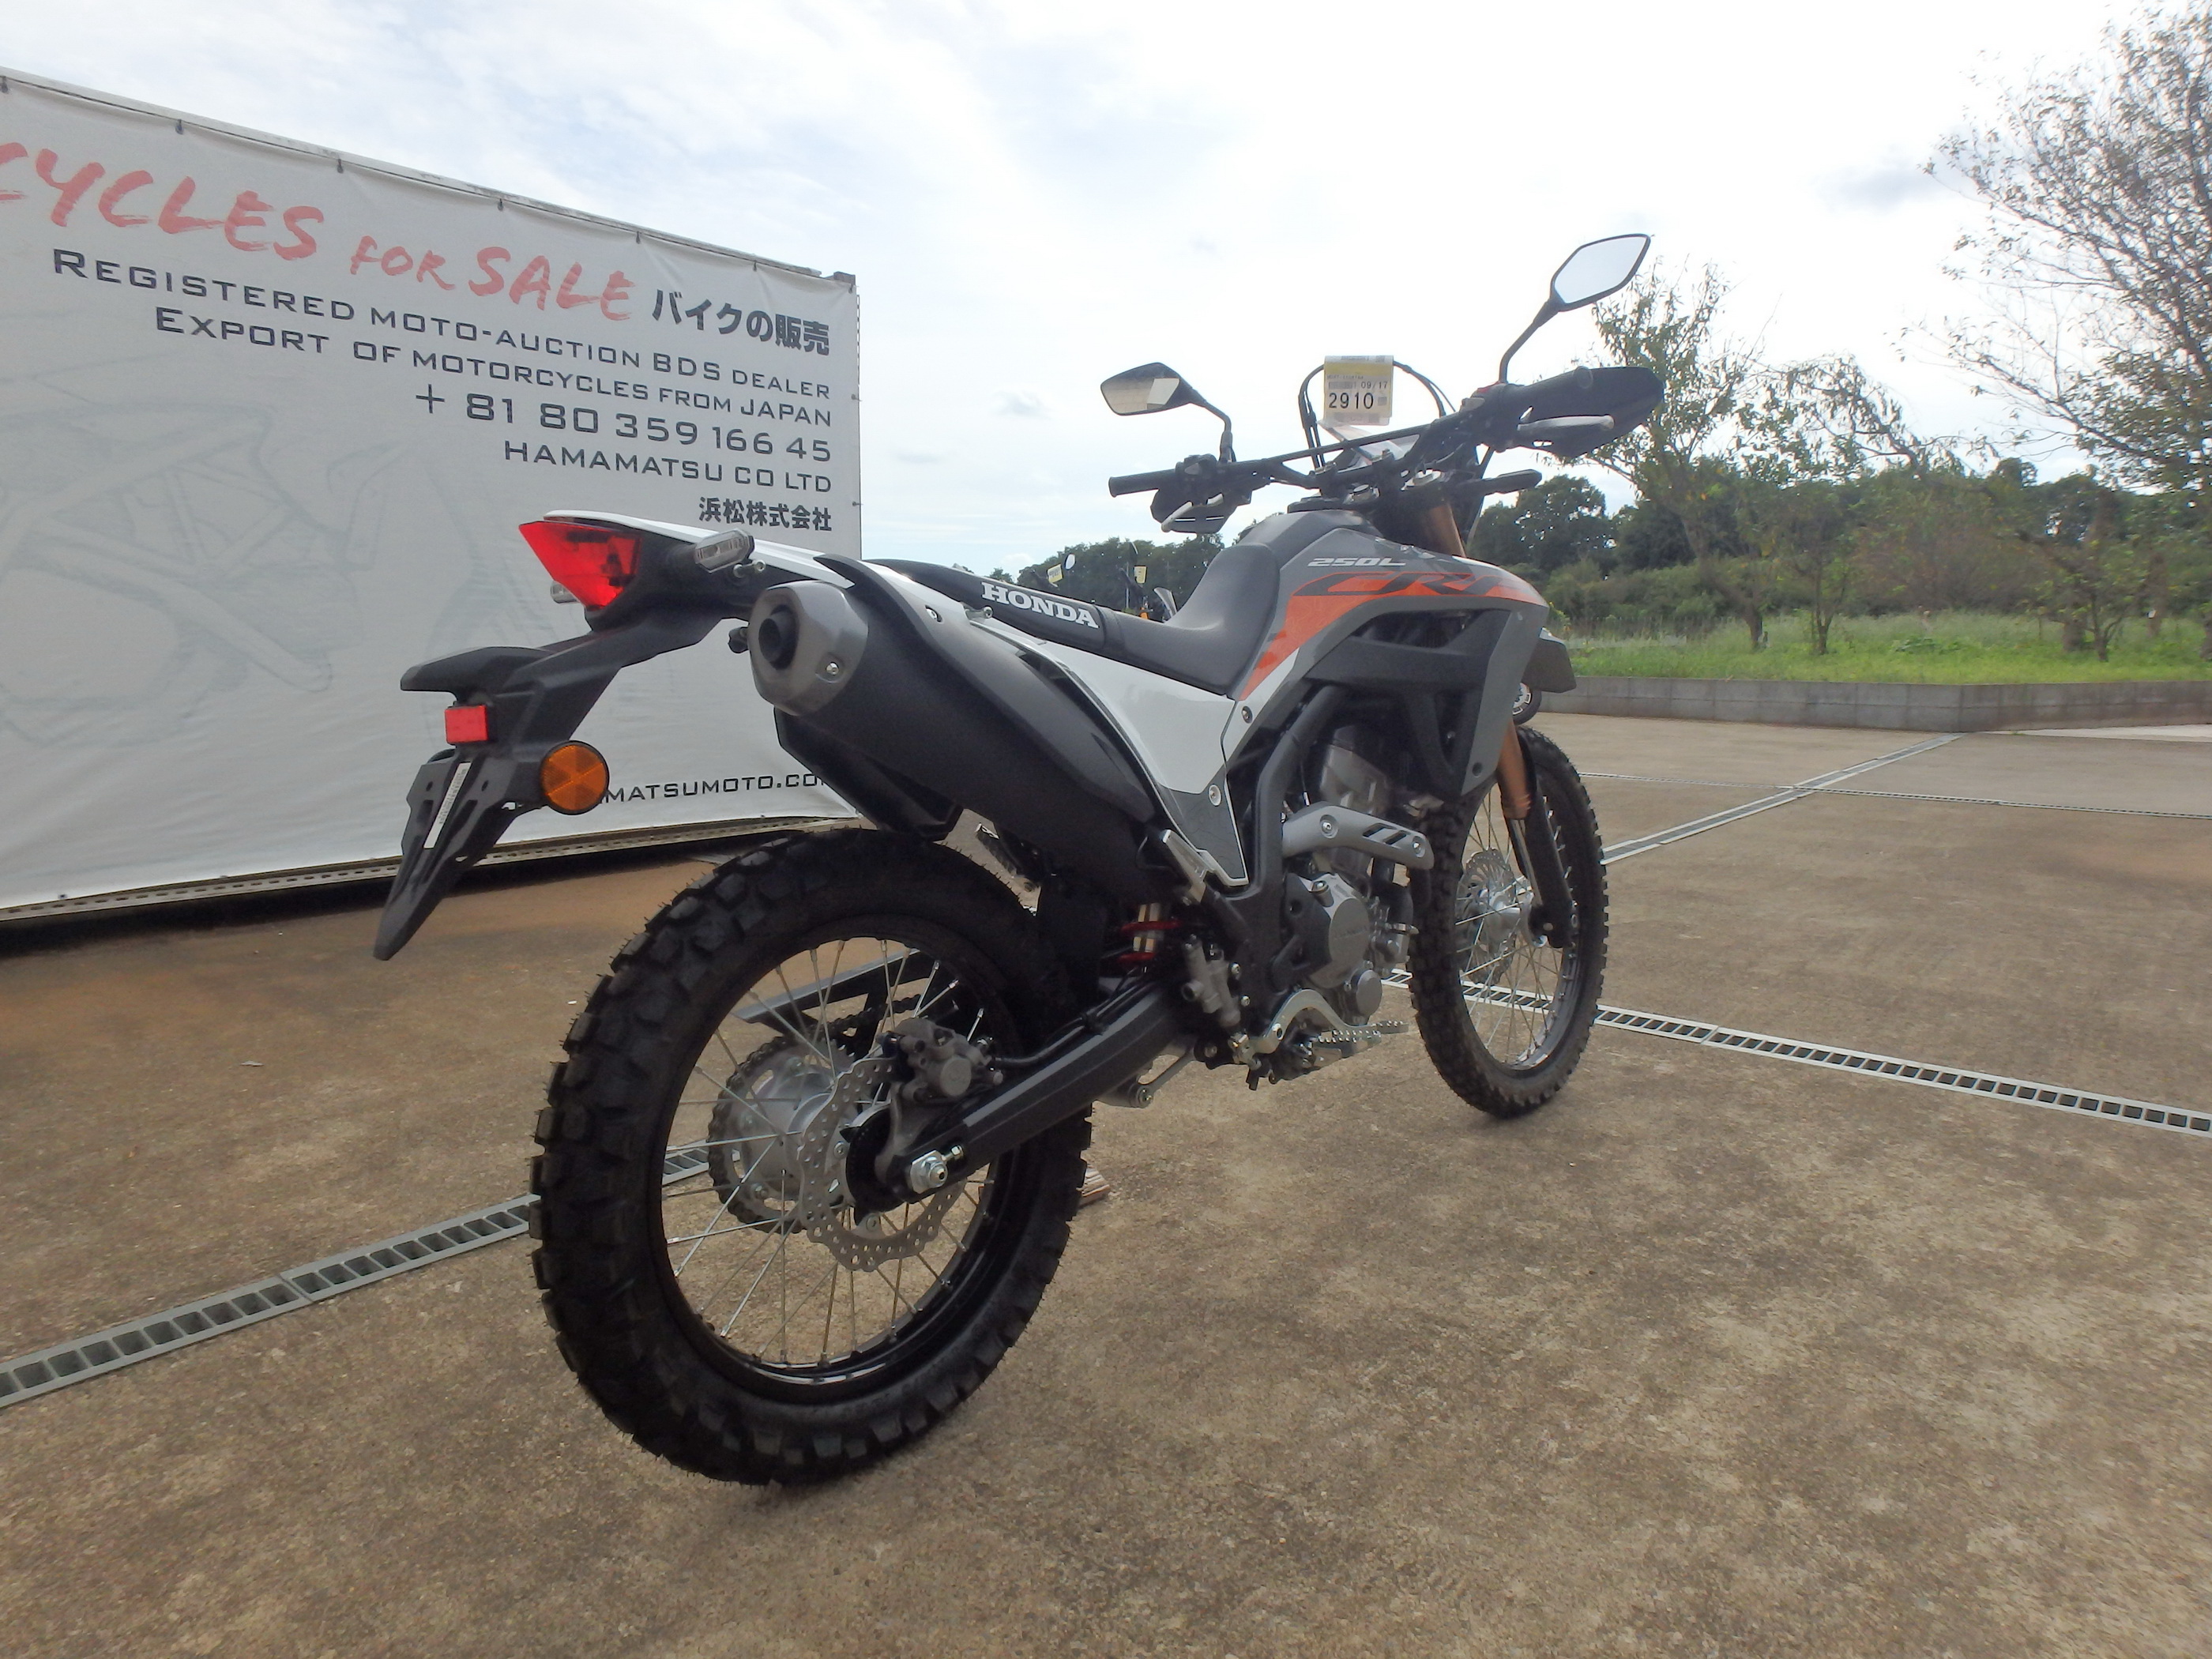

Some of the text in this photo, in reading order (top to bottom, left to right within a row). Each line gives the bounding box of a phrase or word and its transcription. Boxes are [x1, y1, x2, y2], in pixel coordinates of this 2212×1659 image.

[350, 235, 455, 290] FOR
[468, 247, 635, 321] SALE
[53, 248, 830, 400] REGISTERED MOTO-AUCTION BDS DEALER
[652, 289, 830, 356] バイクの販売
[156, 307, 831, 427] EXPORT OF MOTORCYCLES FROM JAPAN
[1360, 381, 1388, 389] 09/17
[1328, 393, 1374, 409] 2910
[467, 393, 514, 423] 81
[540, 404, 599, 434] 80
[615, 412, 698, 444] 359
[713, 426, 773, 455] 166
[785, 439, 831, 462] 45
[505, 440, 832, 494] HAMAMATSU CO LTD
[699, 496, 833, 532] 浜松株式会社
[1290, 570, 1525, 596] CRF
[1307, 557, 1406, 567] 250L
[981, 581, 1100, 629] HONDA
[599, 773, 825, 804] MATSUMOTO.CO
